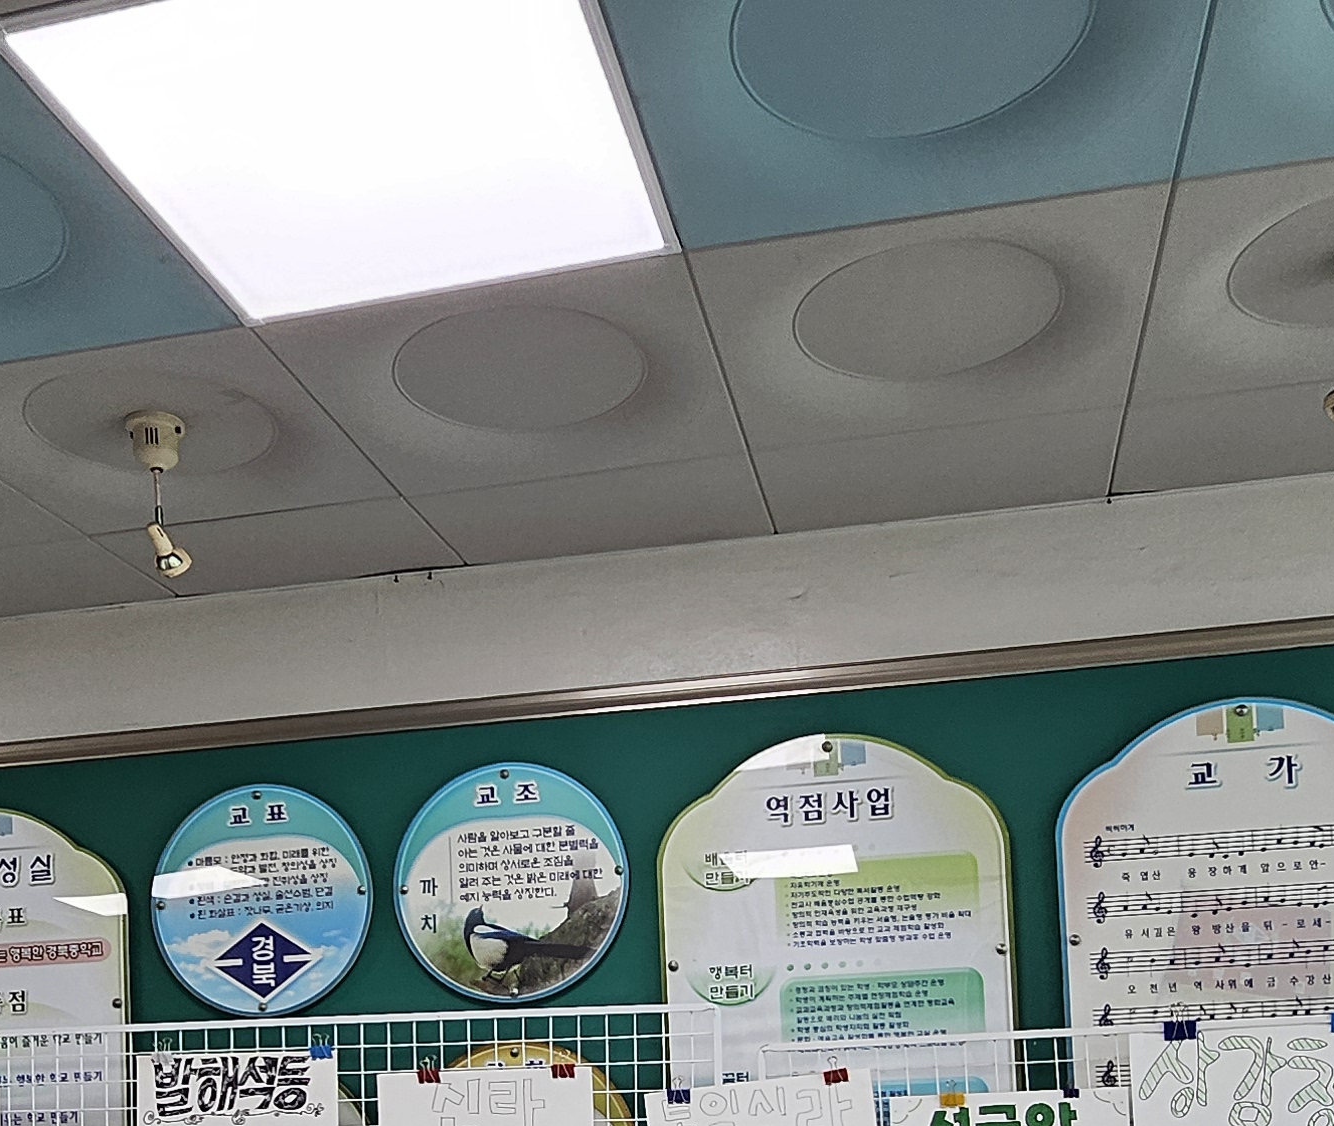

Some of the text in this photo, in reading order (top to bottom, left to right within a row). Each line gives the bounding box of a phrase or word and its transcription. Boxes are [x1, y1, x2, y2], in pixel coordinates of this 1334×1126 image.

[1187, 755, 1299, 787] 교가
[476, 783, 538, 805] 교조
[229, 804, 287, 825] 교표
[766, 787, 893, 824] 역점사업
[457, 825, 576, 844] 사람을 알아보고 구분할 줄
[195, 856, 222, 866] 마름모
[231, 853, 257, 865] 안정과
[282, 848, 309, 859] 미래를
[312, 846, 330, 857] 위한
[458, 838, 599, 859] 아는 것은 사물에 대한 분별력을
[281, 860, 316, 872] 창의성을
[319, 857, 337, 869] 상징
[458, 855, 574, 874] 의미하며 상서로운 조짐을
[272, 872, 328, 886] 진취성을 상징
[459, 867, 603, 889] 알려 주는 것은 밝은 미래에 대한
[224, 893, 250, 905] 순결과
[482, 888, 512, 901] 능력을
[514, 886, 557, 900] 상징한다.
[209, 908, 235, 919] 화살표
[317, 901, 334, 911] 의지
[419, 877, 439, 934] 까치
[9, 946, 44, 962] 행복한
[46, 942, 103, 959] 경북중학교
[250, 935, 276, 988] 경북
[708, 964, 753, 980] 행복터
[709, 984, 754, 1000] 만들기
[151, 1055, 312, 1118] 발해석등
